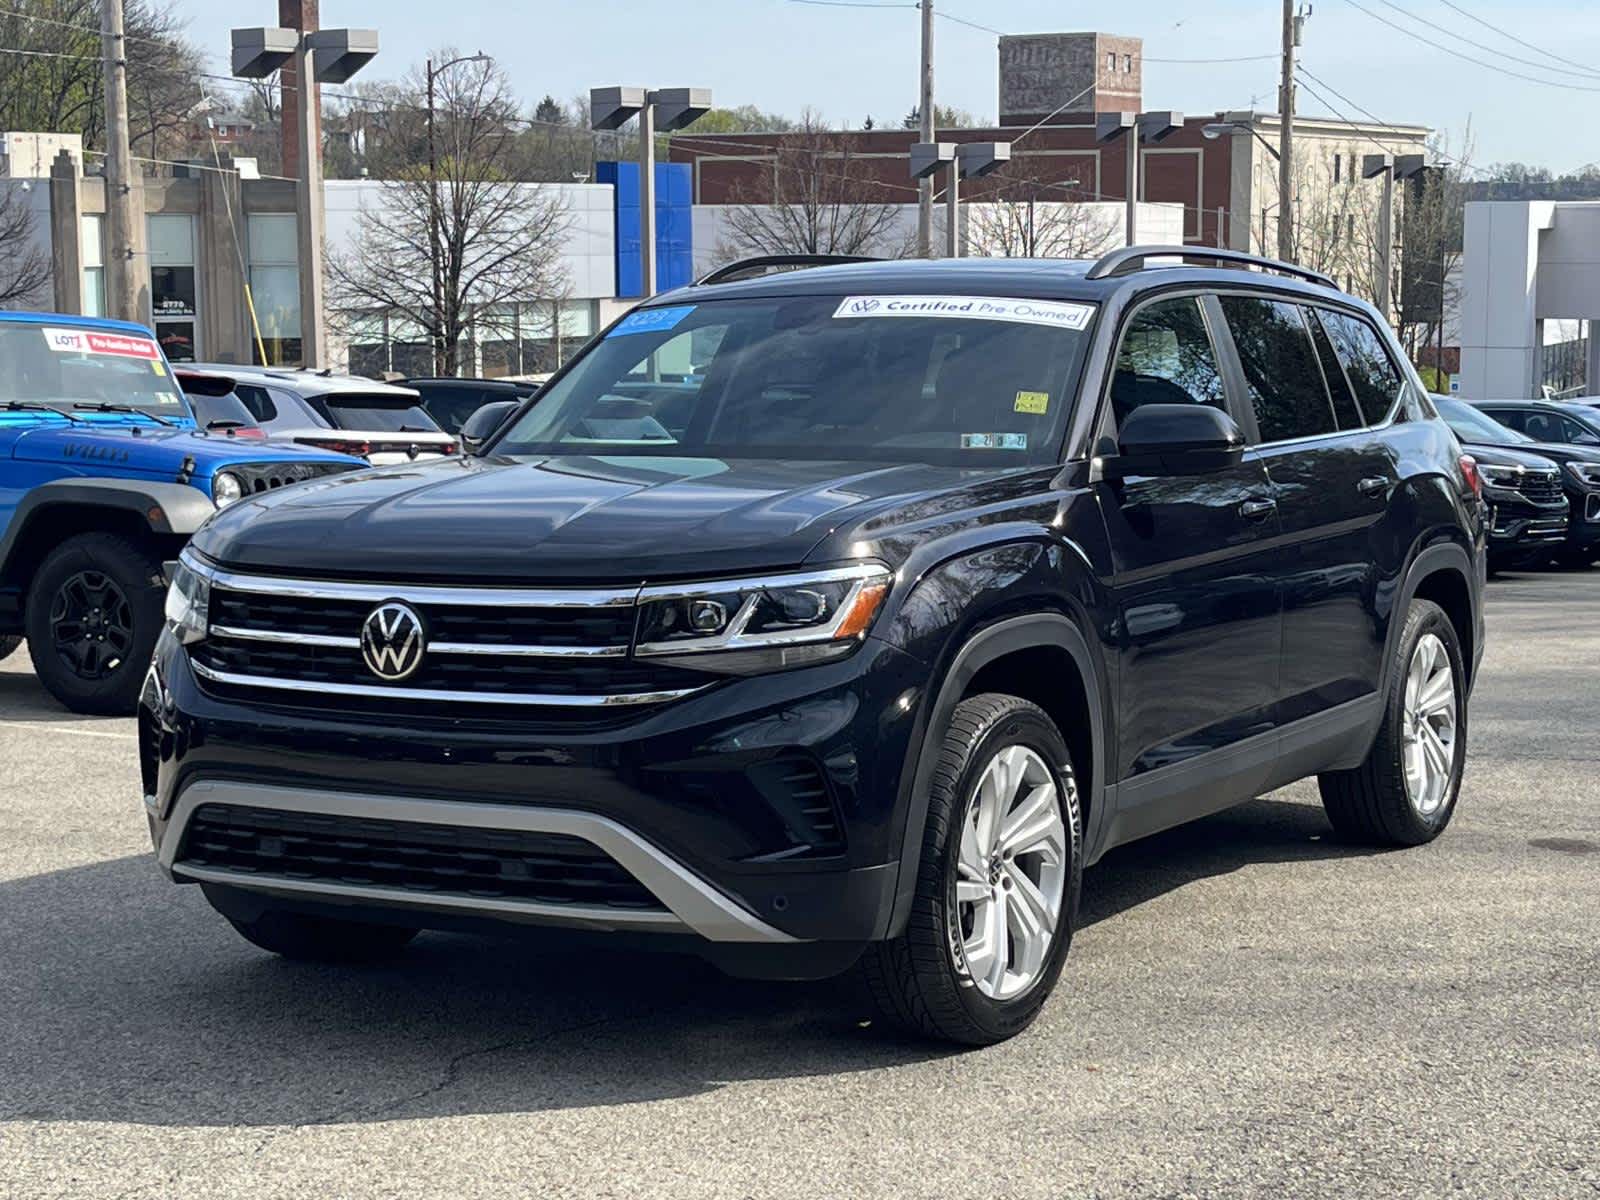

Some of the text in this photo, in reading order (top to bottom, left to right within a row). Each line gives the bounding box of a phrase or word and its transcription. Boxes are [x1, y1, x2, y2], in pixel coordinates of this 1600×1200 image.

[887, 301, 1080, 322] Certified Pre-Owned
[361, 602, 424, 679] VW
